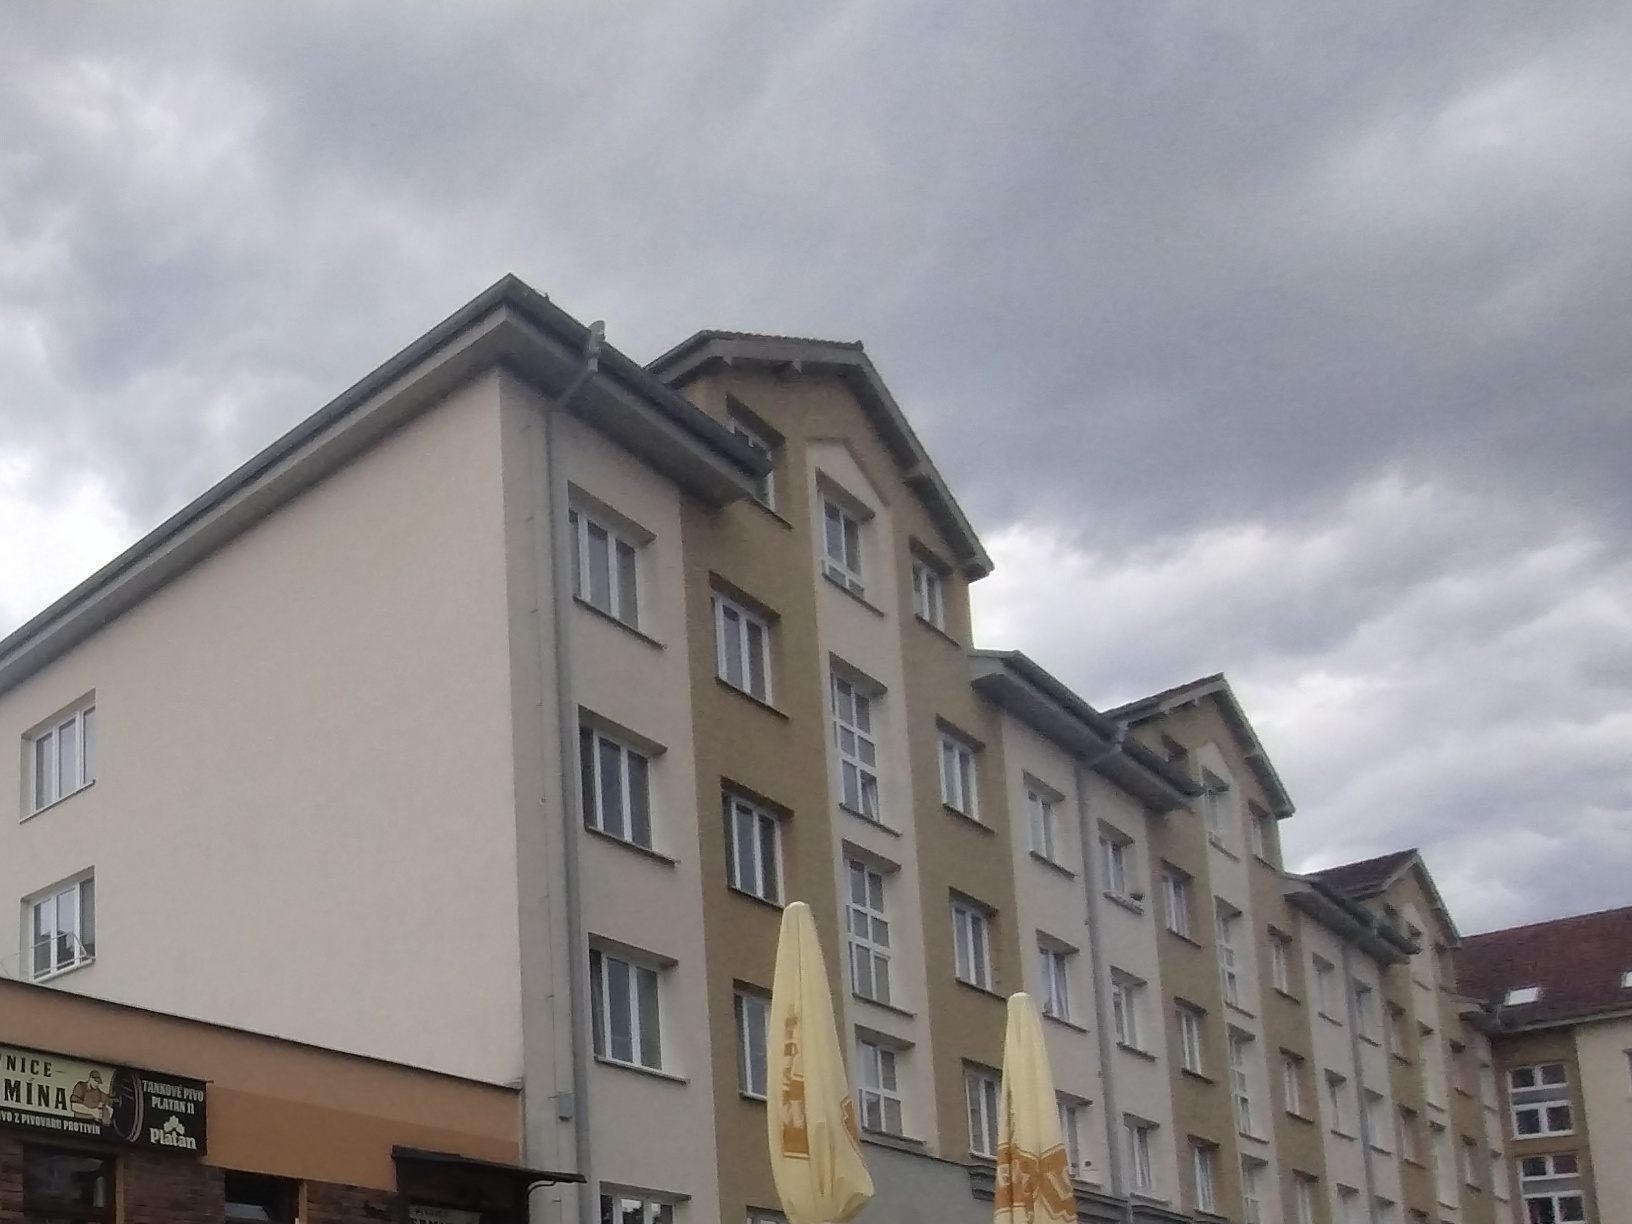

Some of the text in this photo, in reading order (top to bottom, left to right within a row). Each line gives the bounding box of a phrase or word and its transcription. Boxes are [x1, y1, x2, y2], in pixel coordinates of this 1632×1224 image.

[142, 1080, 204, 1102] TANKOVÉ PIVO
[151, 1096, 195, 1115] PLATAN 11
[14, 1112, 20, 1124] Z
[21, 1113, 62, 1130] PIVOVARU
[63, 1120, 102, 1136] PROTIVÍN
[149, 1127, 197, 1150] Platan
